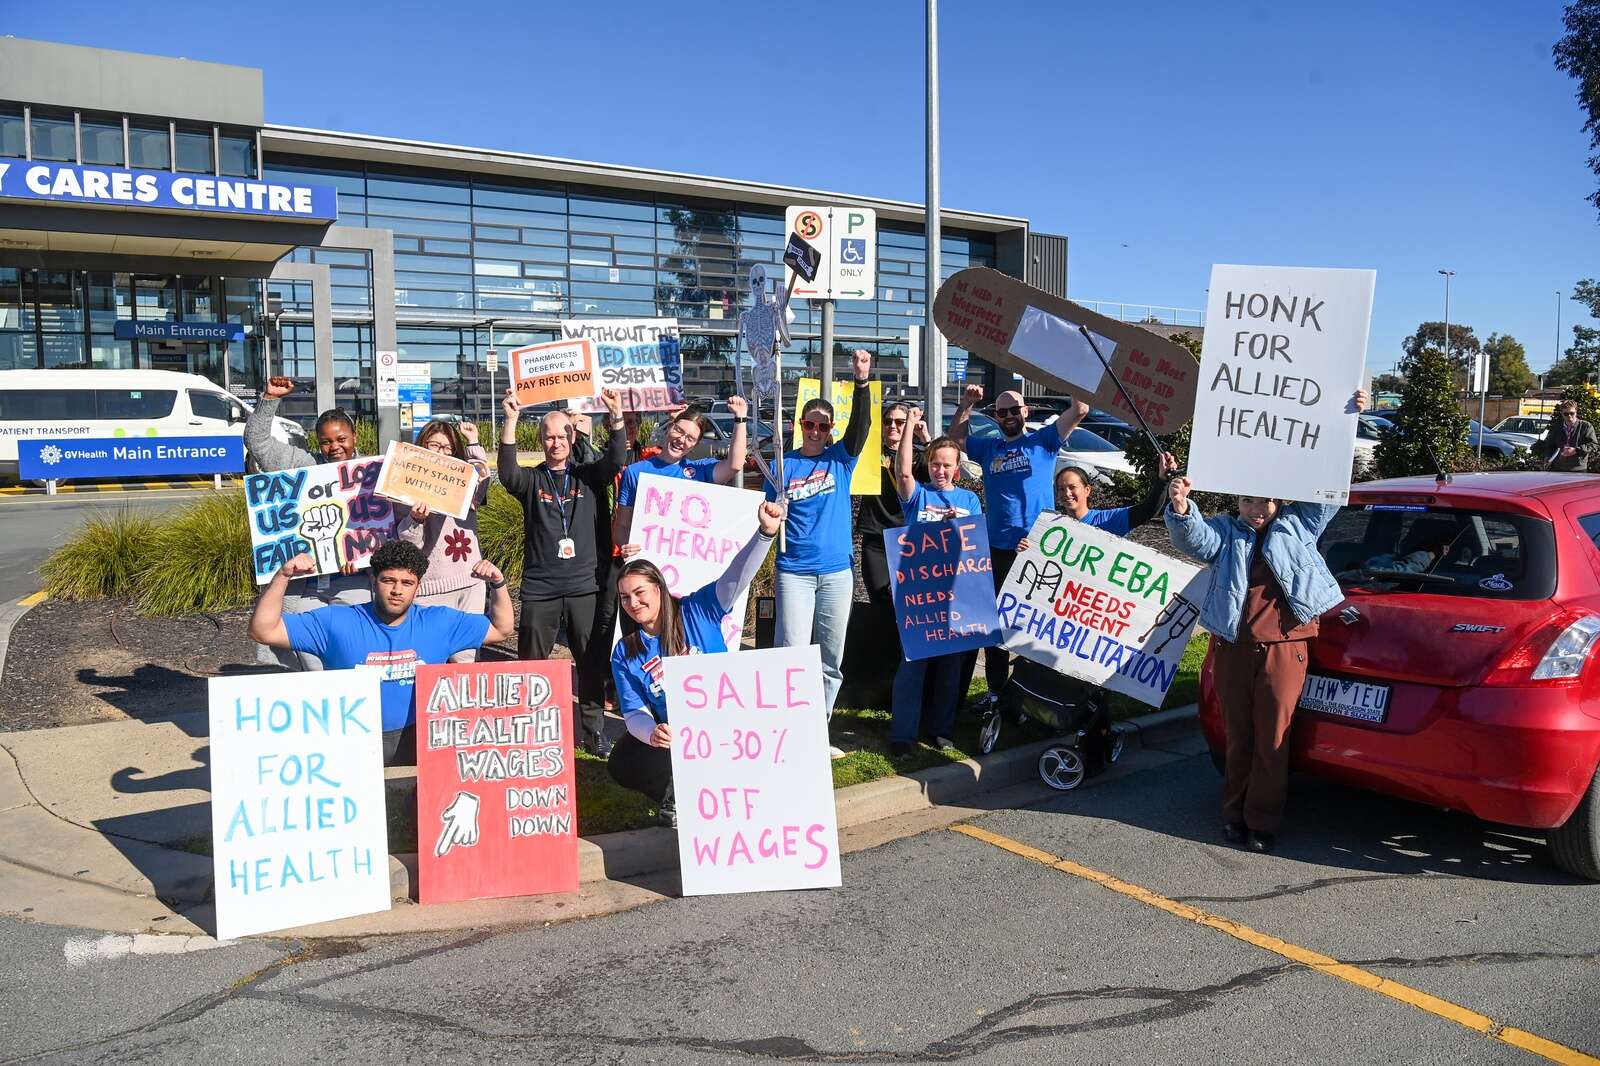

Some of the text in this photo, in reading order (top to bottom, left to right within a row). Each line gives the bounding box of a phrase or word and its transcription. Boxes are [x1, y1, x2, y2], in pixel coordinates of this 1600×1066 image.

[26, 166, 159, 202] CARES
[171, 178, 312, 213] CENTRE
[848, 213, 865, 234] P
[840, 268, 863, 277] ONLY
[1225, 291, 1325, 332] HONK
[135, 324, 226, 337] Main Entrance
[563, 325, 679, 342] WITHOUT THE
[1234, 331, 1293, 363] FOR
[524, 351, 578, 365] PHARMACISTS
[528, 361, 566, 374] DESERVE
[516, 372, 592, 392] PAY RISE NOW
[602, 366, 681, 384] SYSTEM IS
[1121, 366, 1175, 399] BAND-AID
[1211, 362, 1322, 406] ALLIED
[37, 427, 91, 435] TRANSPORT
[1217, 405, 1321, 450] HEALTH
[64, 450, 108, 459] GVHealth
[113, 445, 227, 460] Main Entrance
[247, 470, 308, 507] PAY
[405, 476, 448, 496] WITH US
[431, 470, 467, 488] STARTS
[255, 502, 300, 535] US
[347, 493, 393, 523] US
[644, 486, 712, 529] NO
[898, 523, 977, 558] SAFE
[1040, 526, 1171, 606] OUR EBA
[904, 590, 958, 607] NEEDS
[1062, 580, 1136, 619] NEEDS
[904, 611, 961, 630] ALLIED
[924, 623, 989, 641] HEALTH
[1053, 598, 1130, 638] URGENT
[1454, 623, 1506, 633] SWIFT
[997, 592, 1178, 693] REHABILITATION
[426, 673, 551, 714] ALLIED
[682, 668, 811, 710] SALE
[234, 695, 371, 737] HONK
[428, 706, 562, 749] HEALTH
[257, 752, 342, 788] FOR
[456, 747, 564, 783] WAGES
[506, 787, 569, 811] DOWN
[698, 787, 761, 821] OFF
[223, 795, 358, 843] ALLIED
[510, 814, 571, 839] DOWN
[692, 824, 829, 870] WAGES
[229, 846, 372, 895] HEALTH
